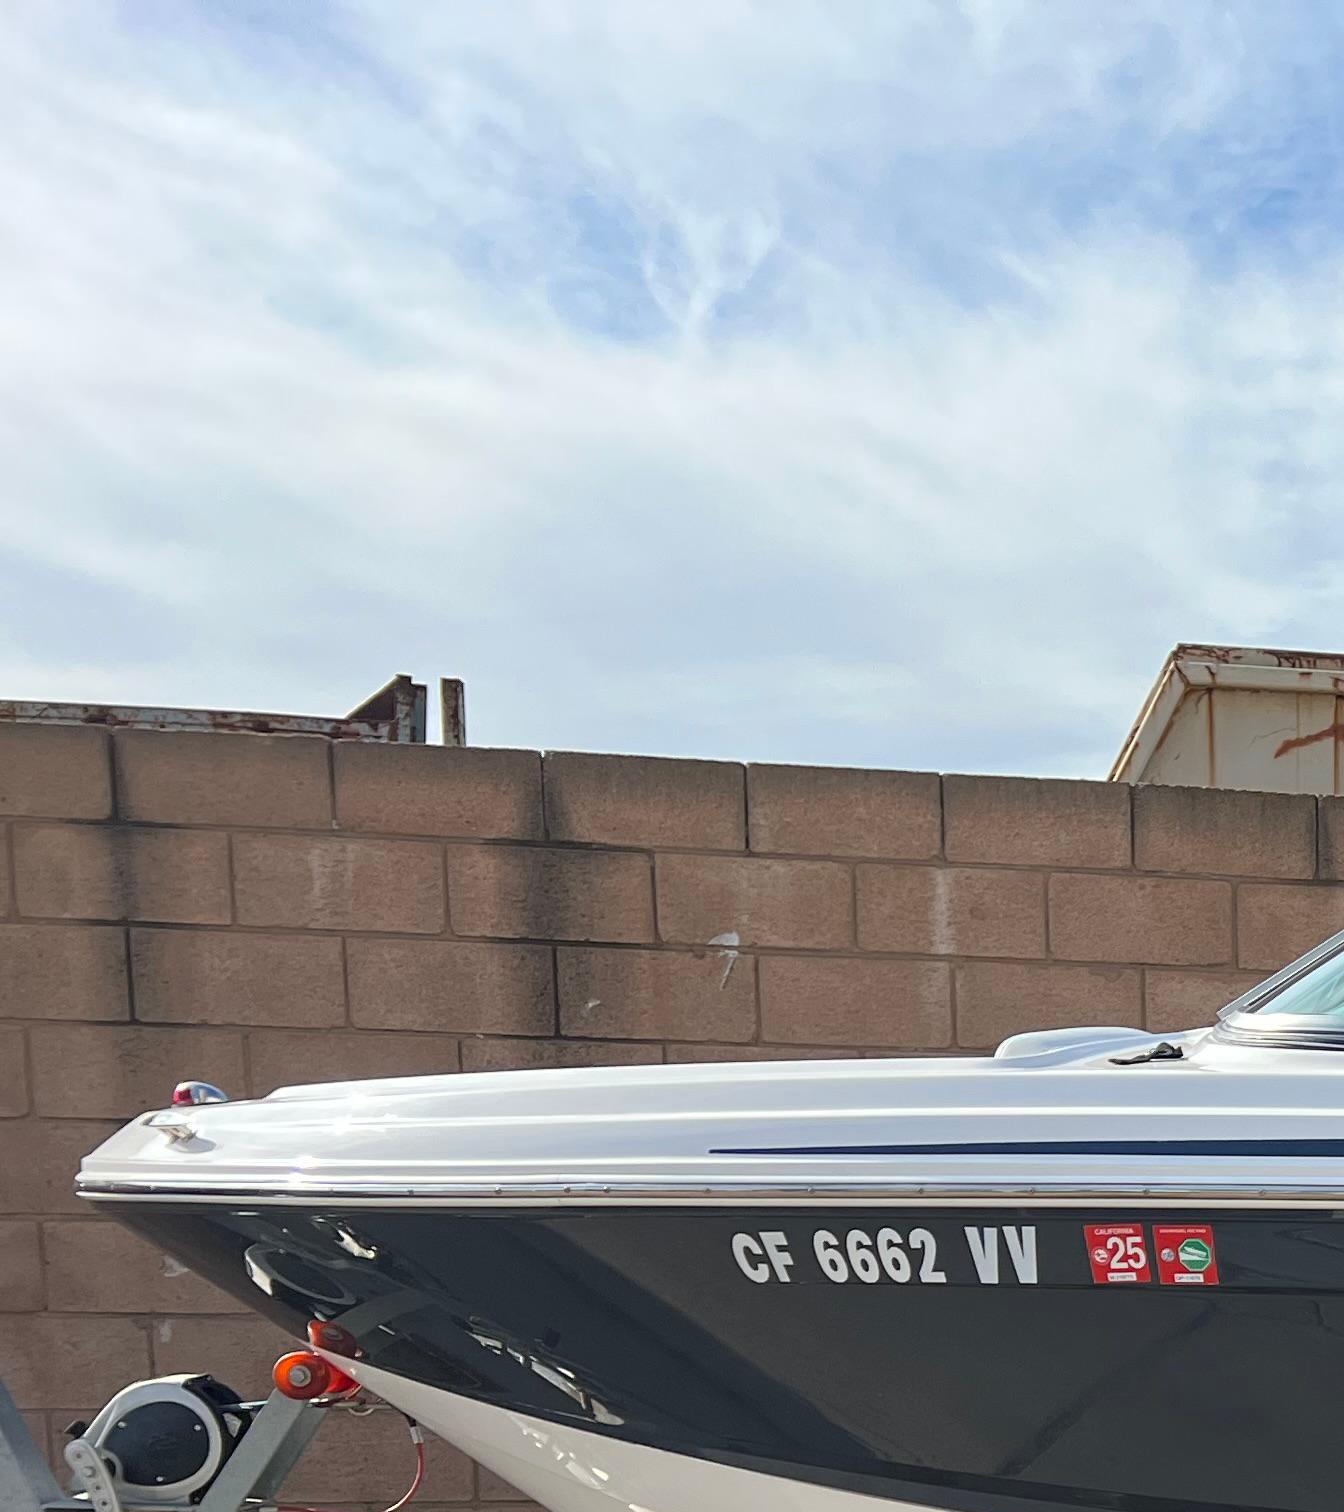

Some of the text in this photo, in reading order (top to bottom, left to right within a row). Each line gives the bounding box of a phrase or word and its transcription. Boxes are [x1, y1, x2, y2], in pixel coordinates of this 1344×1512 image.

[731, 1225, 1039, 1284] CF 6662 VV
[1106, 1236, 1146, 1270] 25
